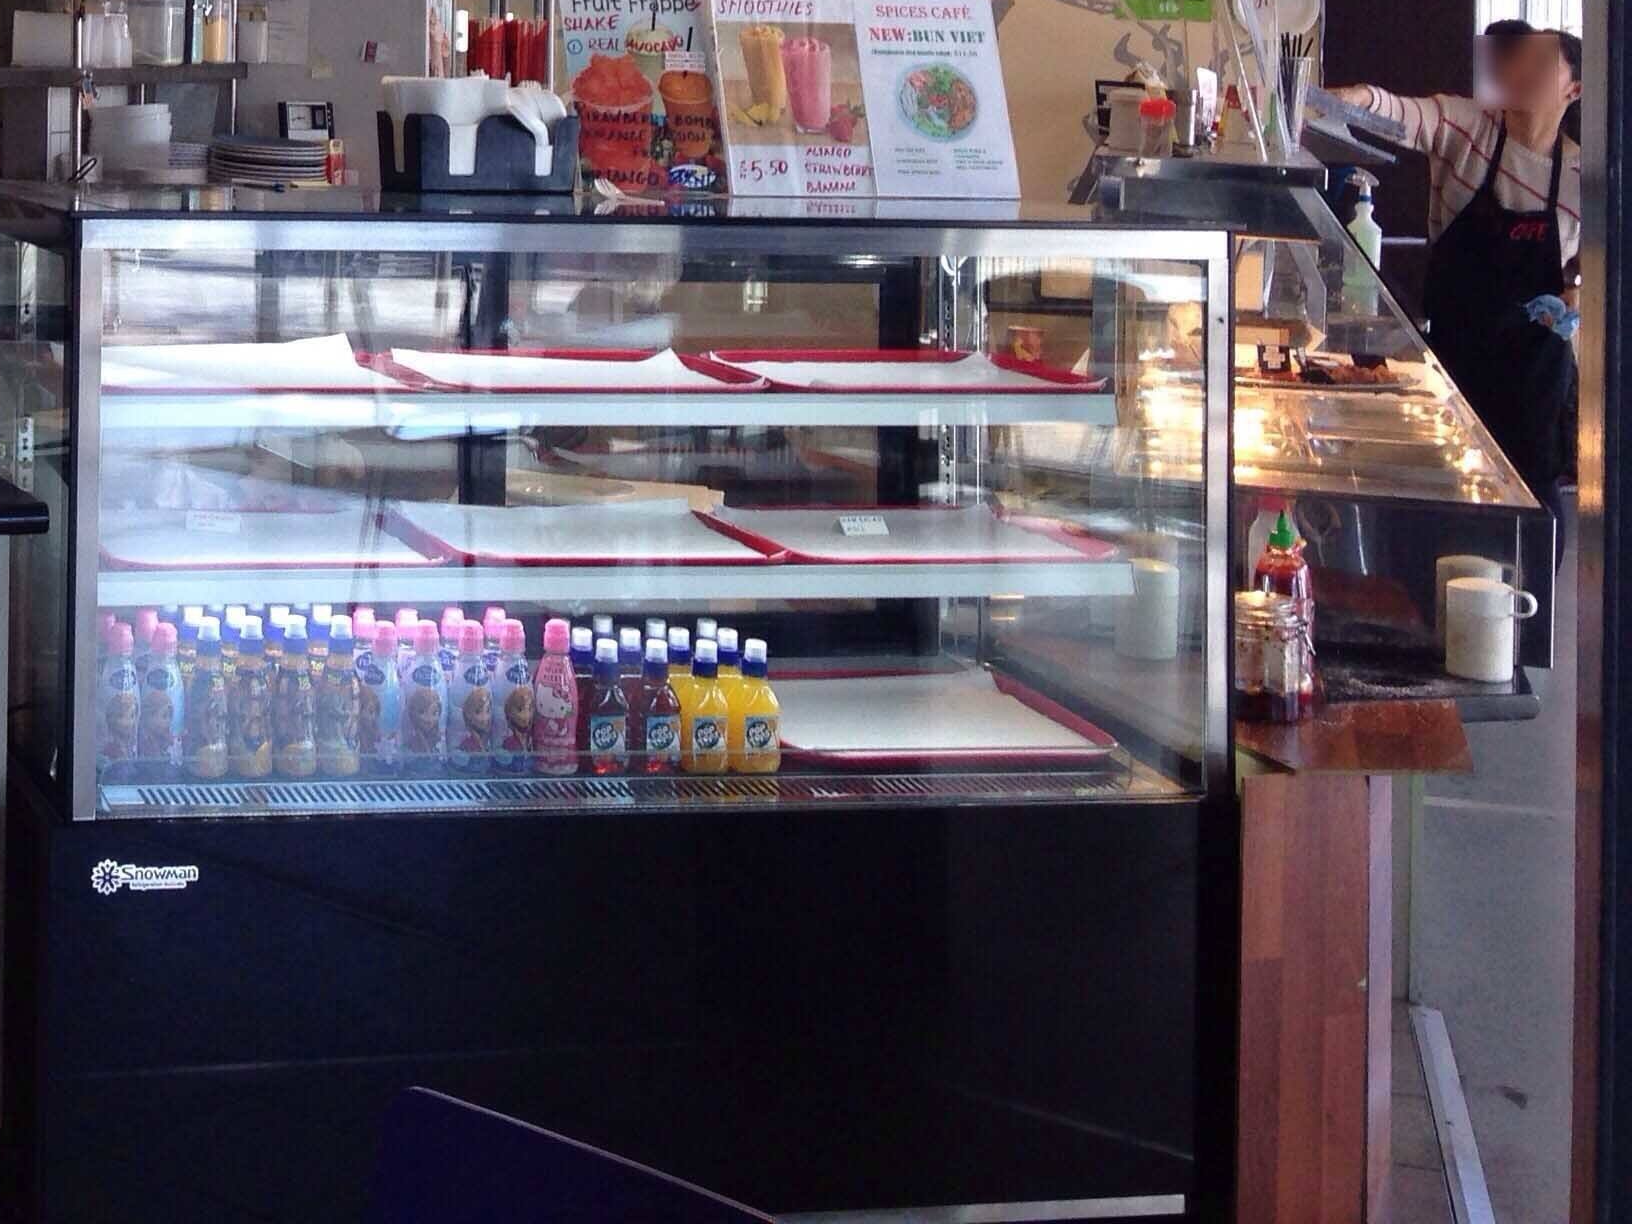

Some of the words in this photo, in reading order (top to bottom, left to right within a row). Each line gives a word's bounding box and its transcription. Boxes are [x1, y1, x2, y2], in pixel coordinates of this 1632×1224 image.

[875, 4, 928, 19] SPICES
[563, 14, 620, 32] SHAKE
[950, 29, 986, 44] VIET
[805, 146, 852, 158] MANGO
[806, 180, 857, 194] BANANA
[120, 865, 198, 881] Snowman
